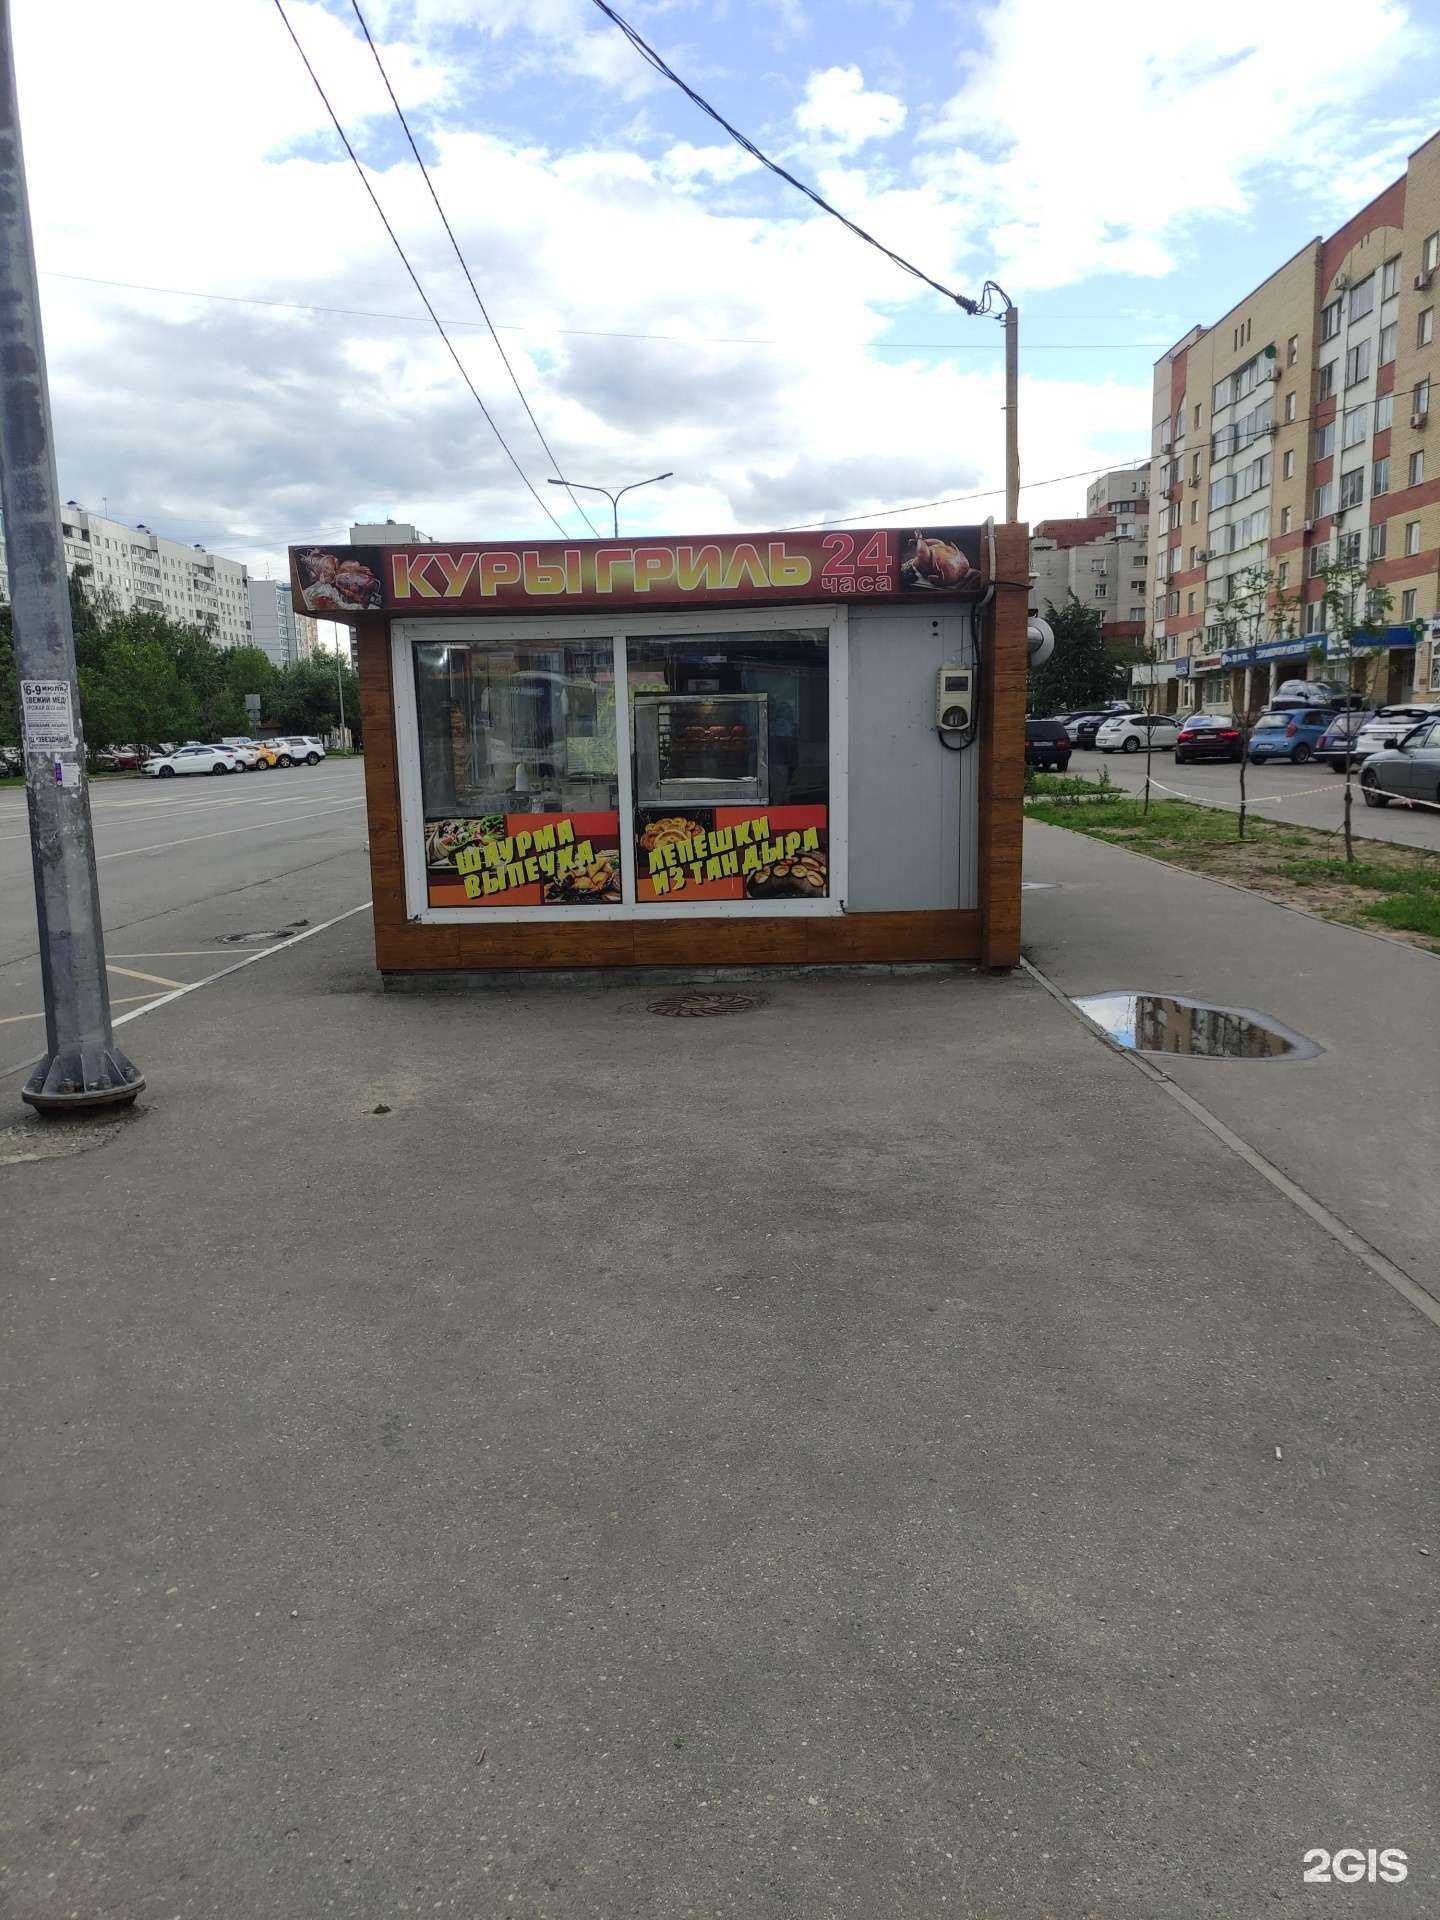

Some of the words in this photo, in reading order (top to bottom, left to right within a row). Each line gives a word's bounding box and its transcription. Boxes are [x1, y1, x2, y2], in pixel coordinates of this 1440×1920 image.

[392, 550, 583, 598] КУРЫ
[594, 543, 812, 594] ГРИЛЬ
[821, 531, 893, 576] 24
[820, 573, 892, 594] часа
[454, 818, 576, 876] ШАУРМА
[463, 839, 596, 899] ВЫПЕЧКА
[648, 815, 771, 875] ЛЕПЕШКИ
[651, 866, 687, 896] ИЗ
[690, 825, 820, 886] ТАНДЫРА
